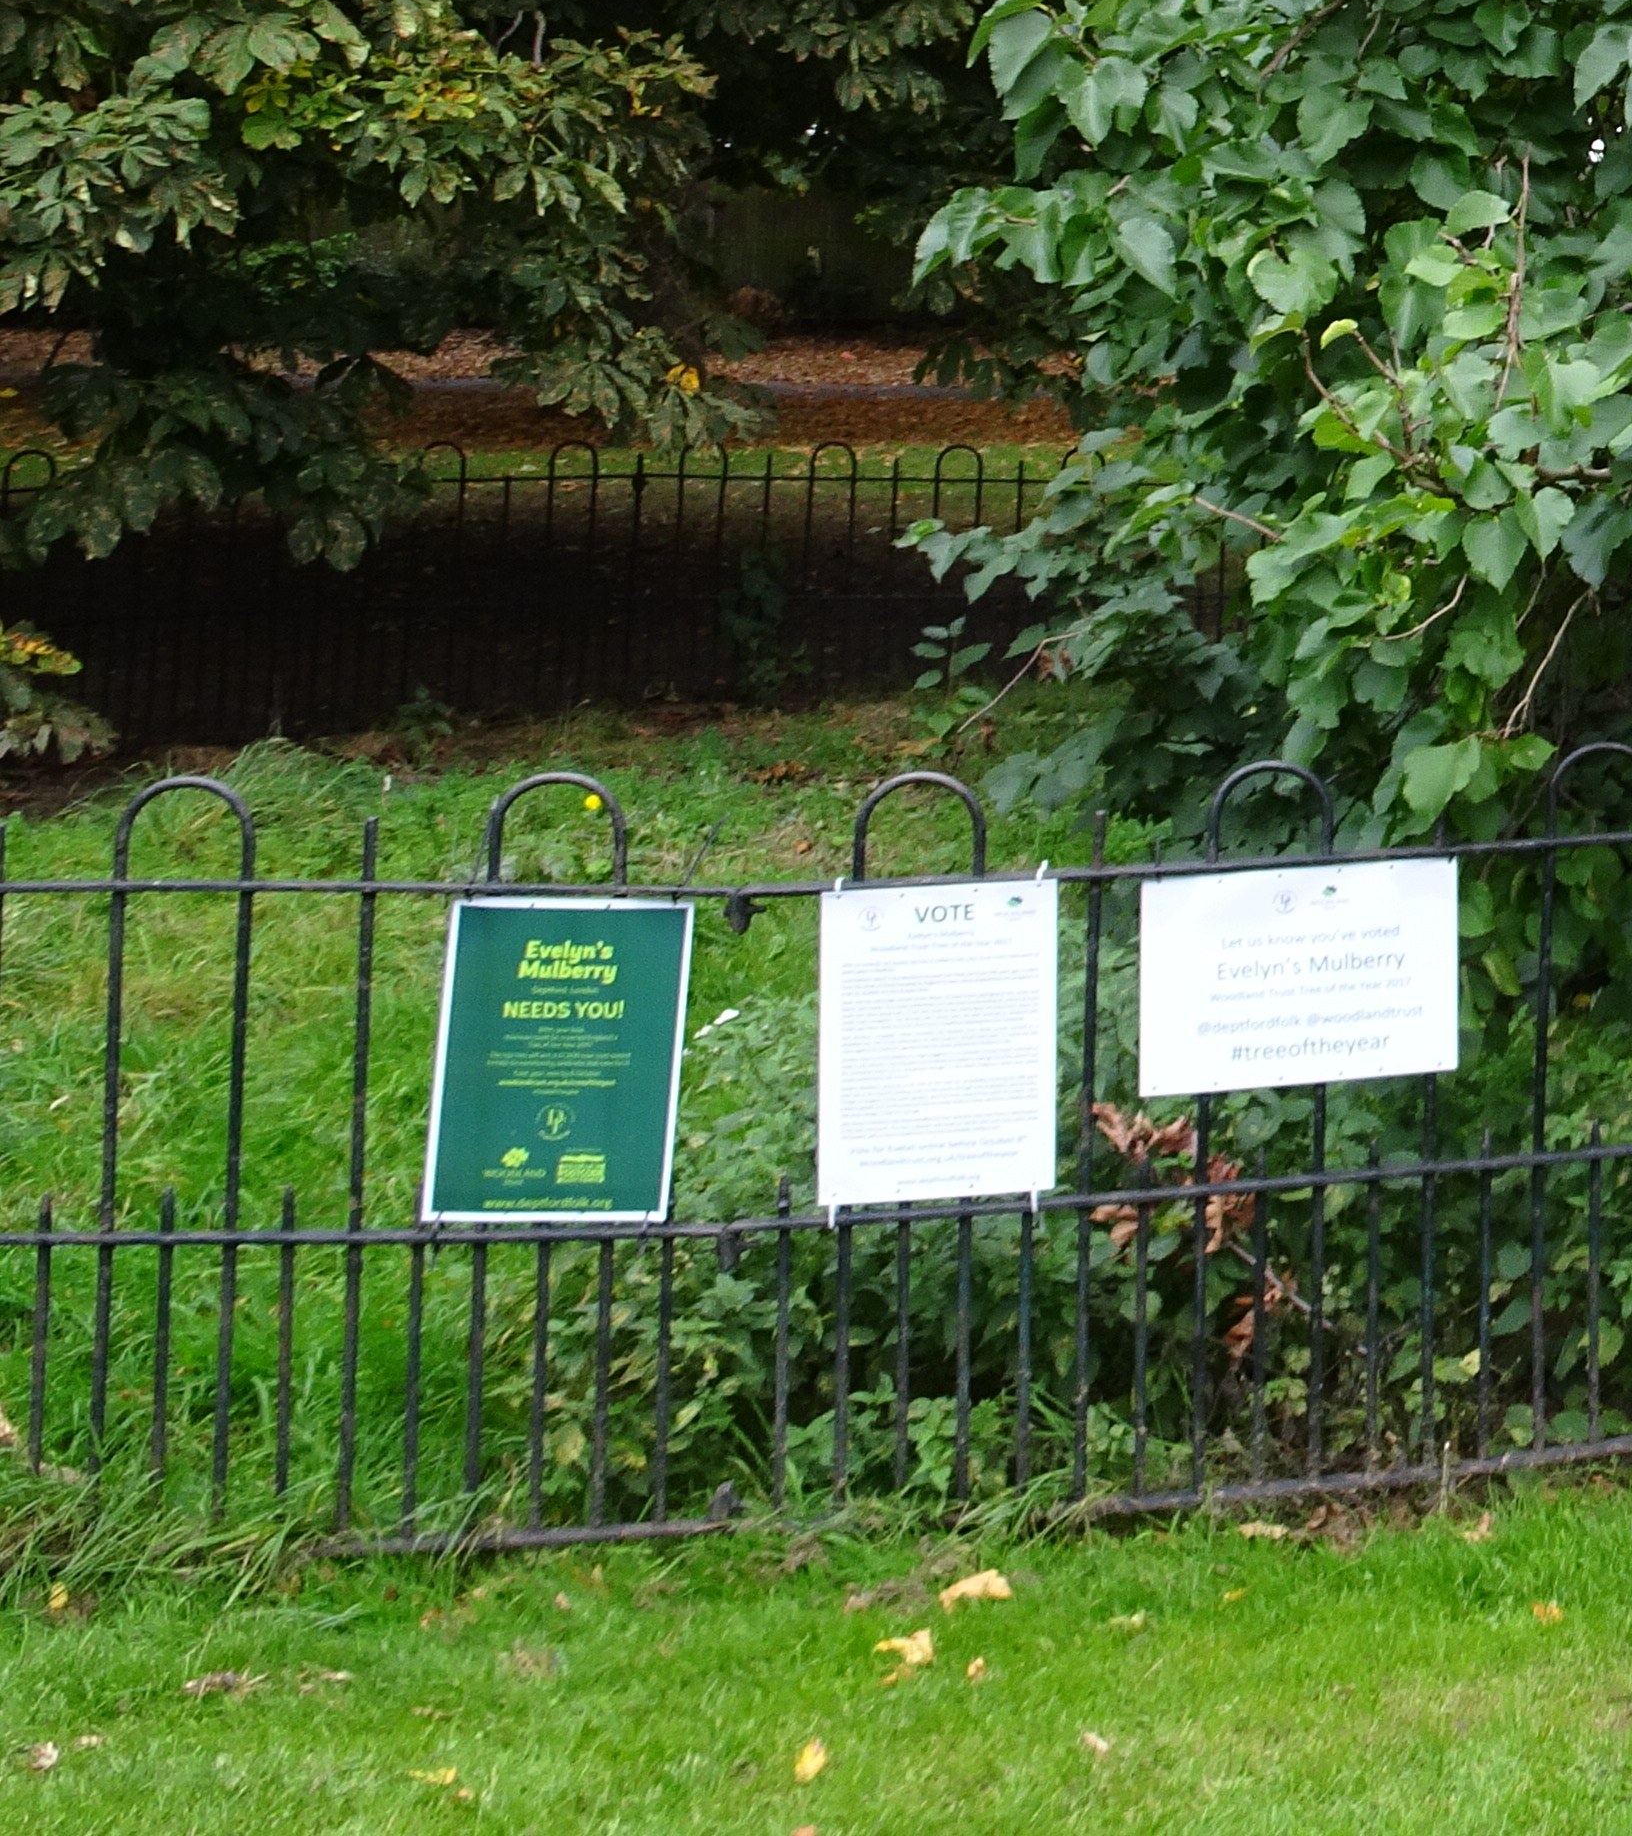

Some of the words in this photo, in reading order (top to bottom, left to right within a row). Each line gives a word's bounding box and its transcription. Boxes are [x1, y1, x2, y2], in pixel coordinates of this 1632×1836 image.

[914, 903, 975, 924] VOTE
[1221, 937, 1243, 950] Let
[1247, 937, 1264, 947] us
[1268, 933, 1306, 946] know
[1360, 924, 1401, 940] voted
[517, 960, 618, 984] Mulberry
[1309, 951, 1406, 974] Mulberry
[1209, 989, 1265, 1003] Woodland
[1325, 983, 1336, 994] of
[1339, 982, 1356, 992] the
[503, 1001, 571, 1018] NEEDS
[574, 1000, 625, 1018] YOU!
[1197, 1014, 1302, 1036] @deptfordfolk
[1306, 1004, 1423, 1028] @woodlandtrust
[1231, 1035, 1391, 1062] #treeoftheyear
